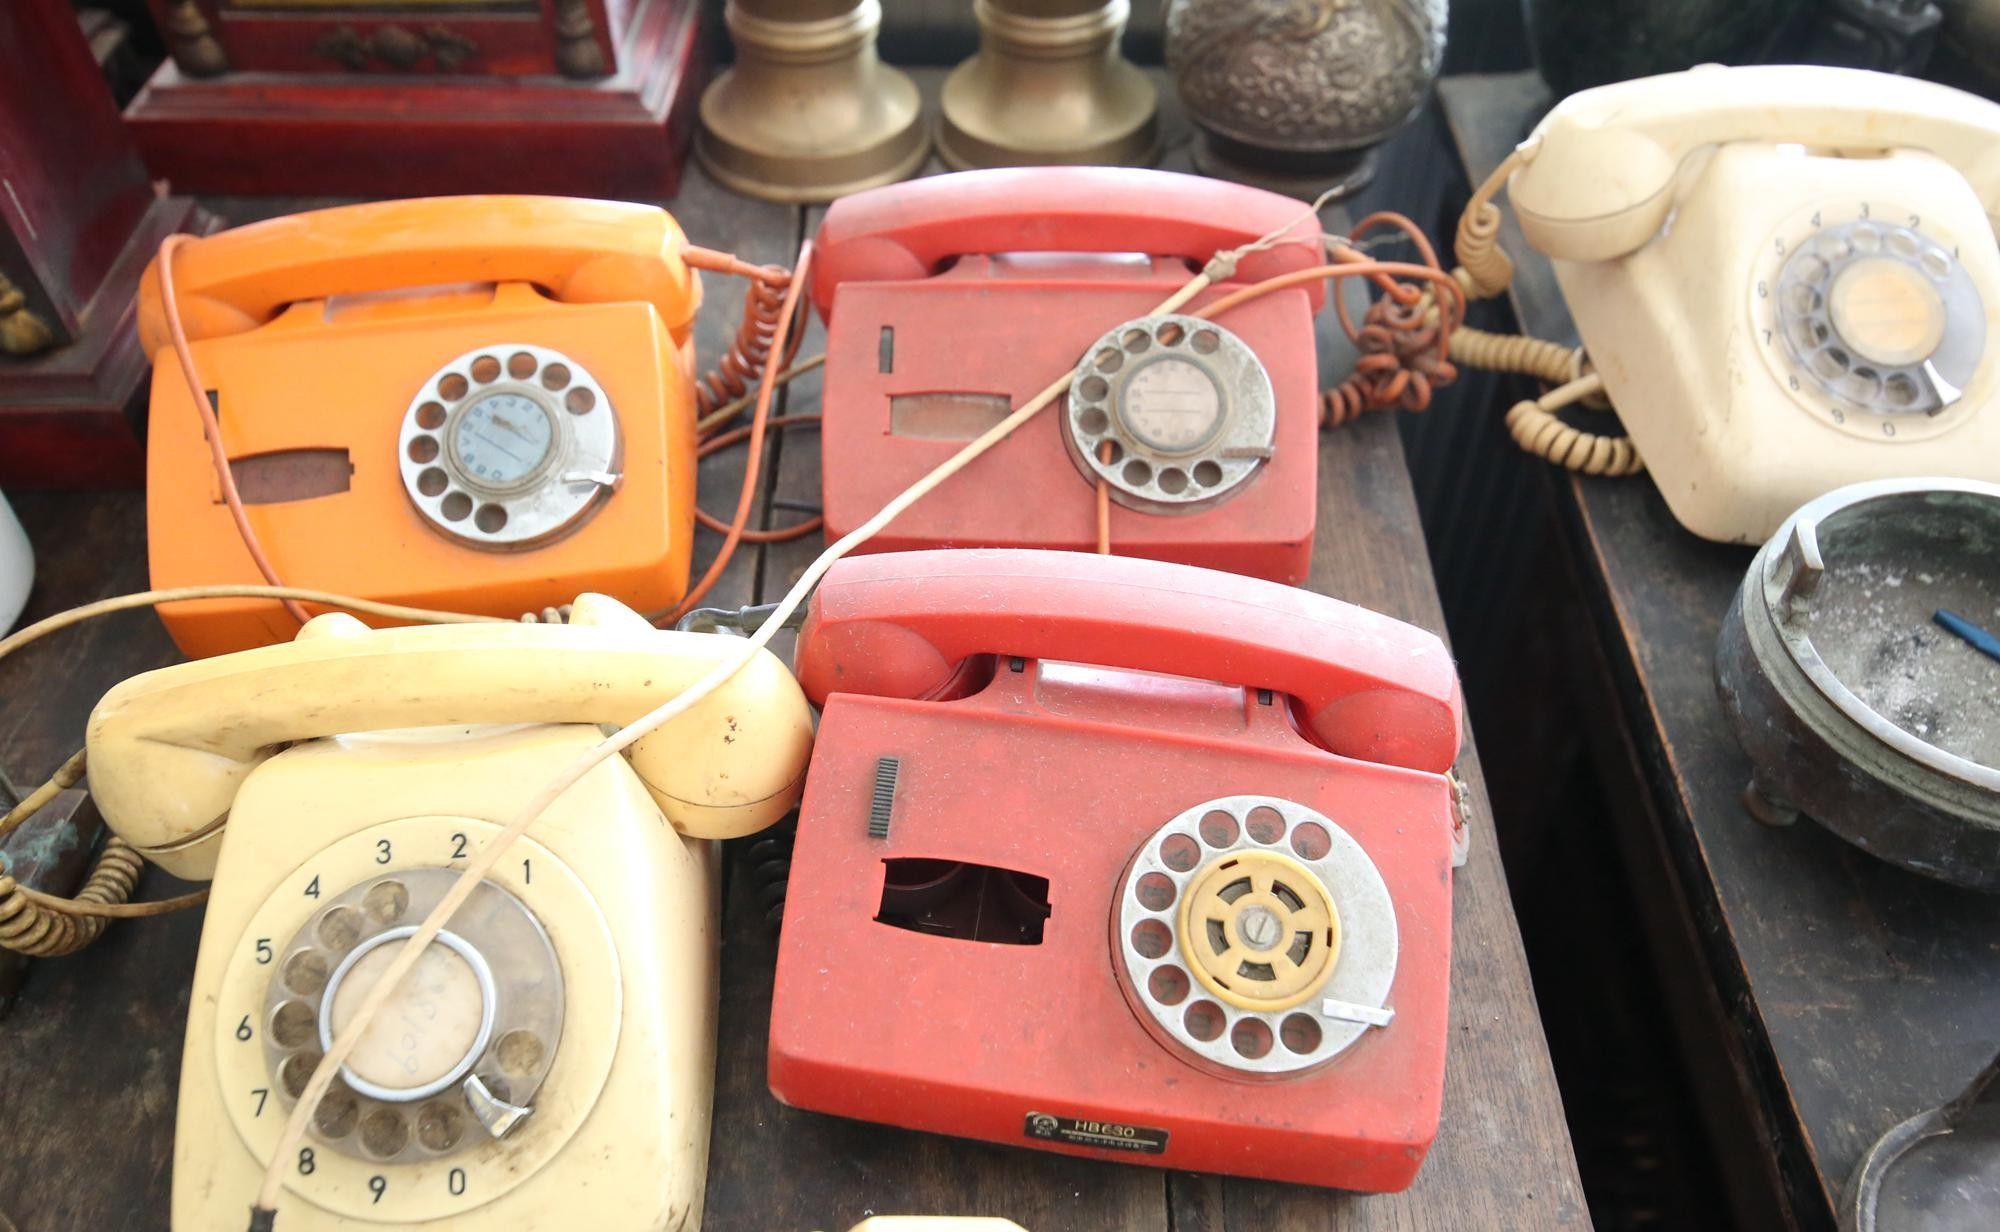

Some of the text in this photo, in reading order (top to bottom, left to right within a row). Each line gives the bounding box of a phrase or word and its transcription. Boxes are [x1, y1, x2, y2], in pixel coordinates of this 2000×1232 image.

[1811, 211, 1822, 228] 4
[1859, 202, 1870, 220] 3
[1909, 214, 1921, 229] 2
[1757, 280, 1768, 299] 6
[1762, 328, 1772, 346] 7
[1882, 421, 1896, 437] 0
[235, 832, 531, 1204] 1 2 3 4 5 6 7 8 9 0
[1074, 1119, 1136, 1139] HB630
